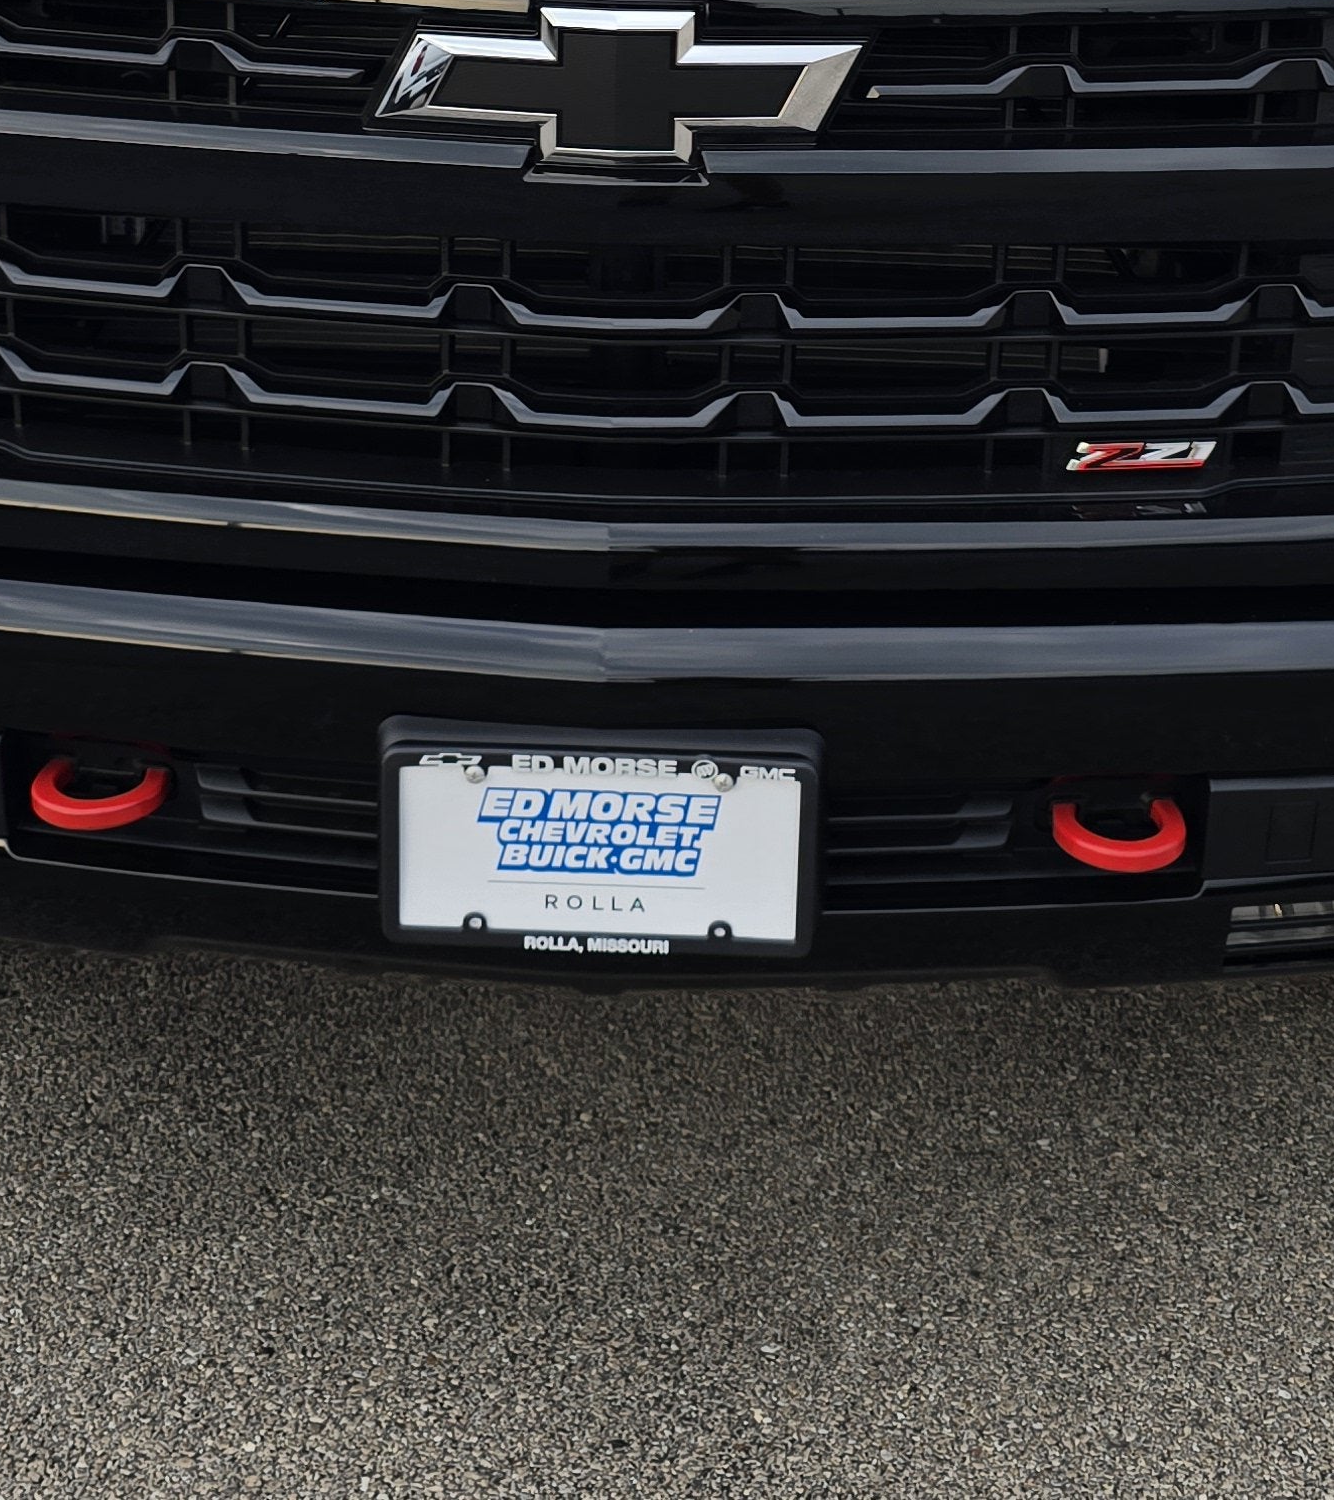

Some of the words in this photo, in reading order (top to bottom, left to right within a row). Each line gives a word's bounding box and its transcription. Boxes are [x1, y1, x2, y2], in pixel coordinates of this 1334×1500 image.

[1066, 441, 1217, 471] Z71
[512, 754, 555, 773] ED
[563, 755, 678, 777] MORSE
[739, 765, 796, 781] GMC
[480, 789, 546, 818] ED
[547, 790, 719, 824] MORSE
[545, 894, 645, 912] ROLLA
[523, 935, 584, 954] ROLLA,
[587, 937, 670, 955] MISSOURI
